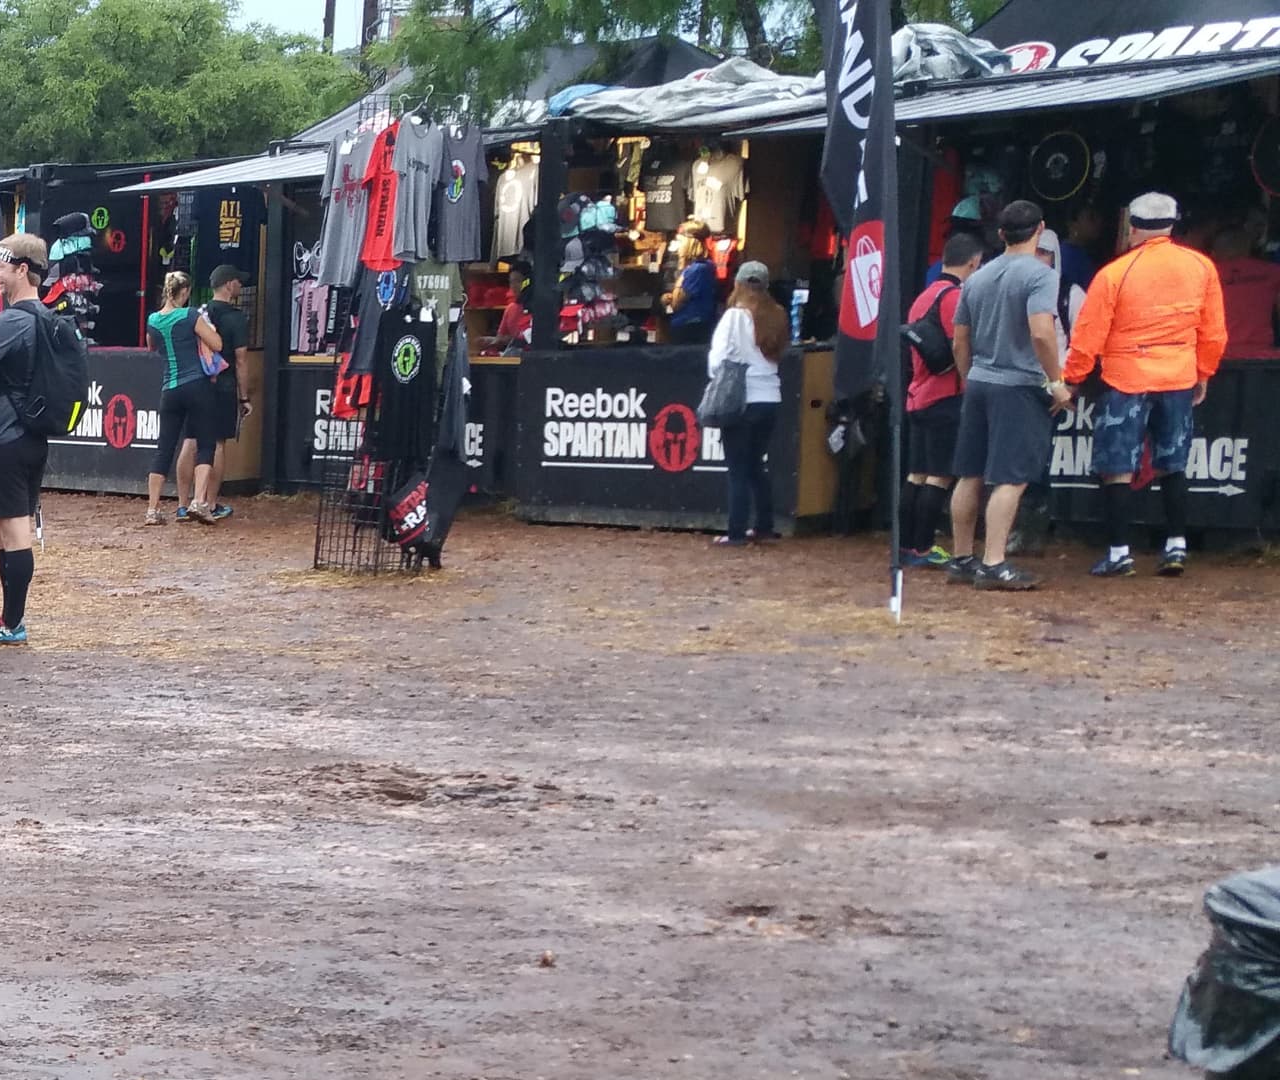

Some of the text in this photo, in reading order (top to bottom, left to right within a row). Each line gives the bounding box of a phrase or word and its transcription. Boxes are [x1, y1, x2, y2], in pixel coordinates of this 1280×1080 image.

[1057, 16, 1280, 68] SPART
[545, 387, 647, 419] Reebok
[543, 421, 647, 459] SPARTAN
[1185, 437, 1248, 481] ACE
